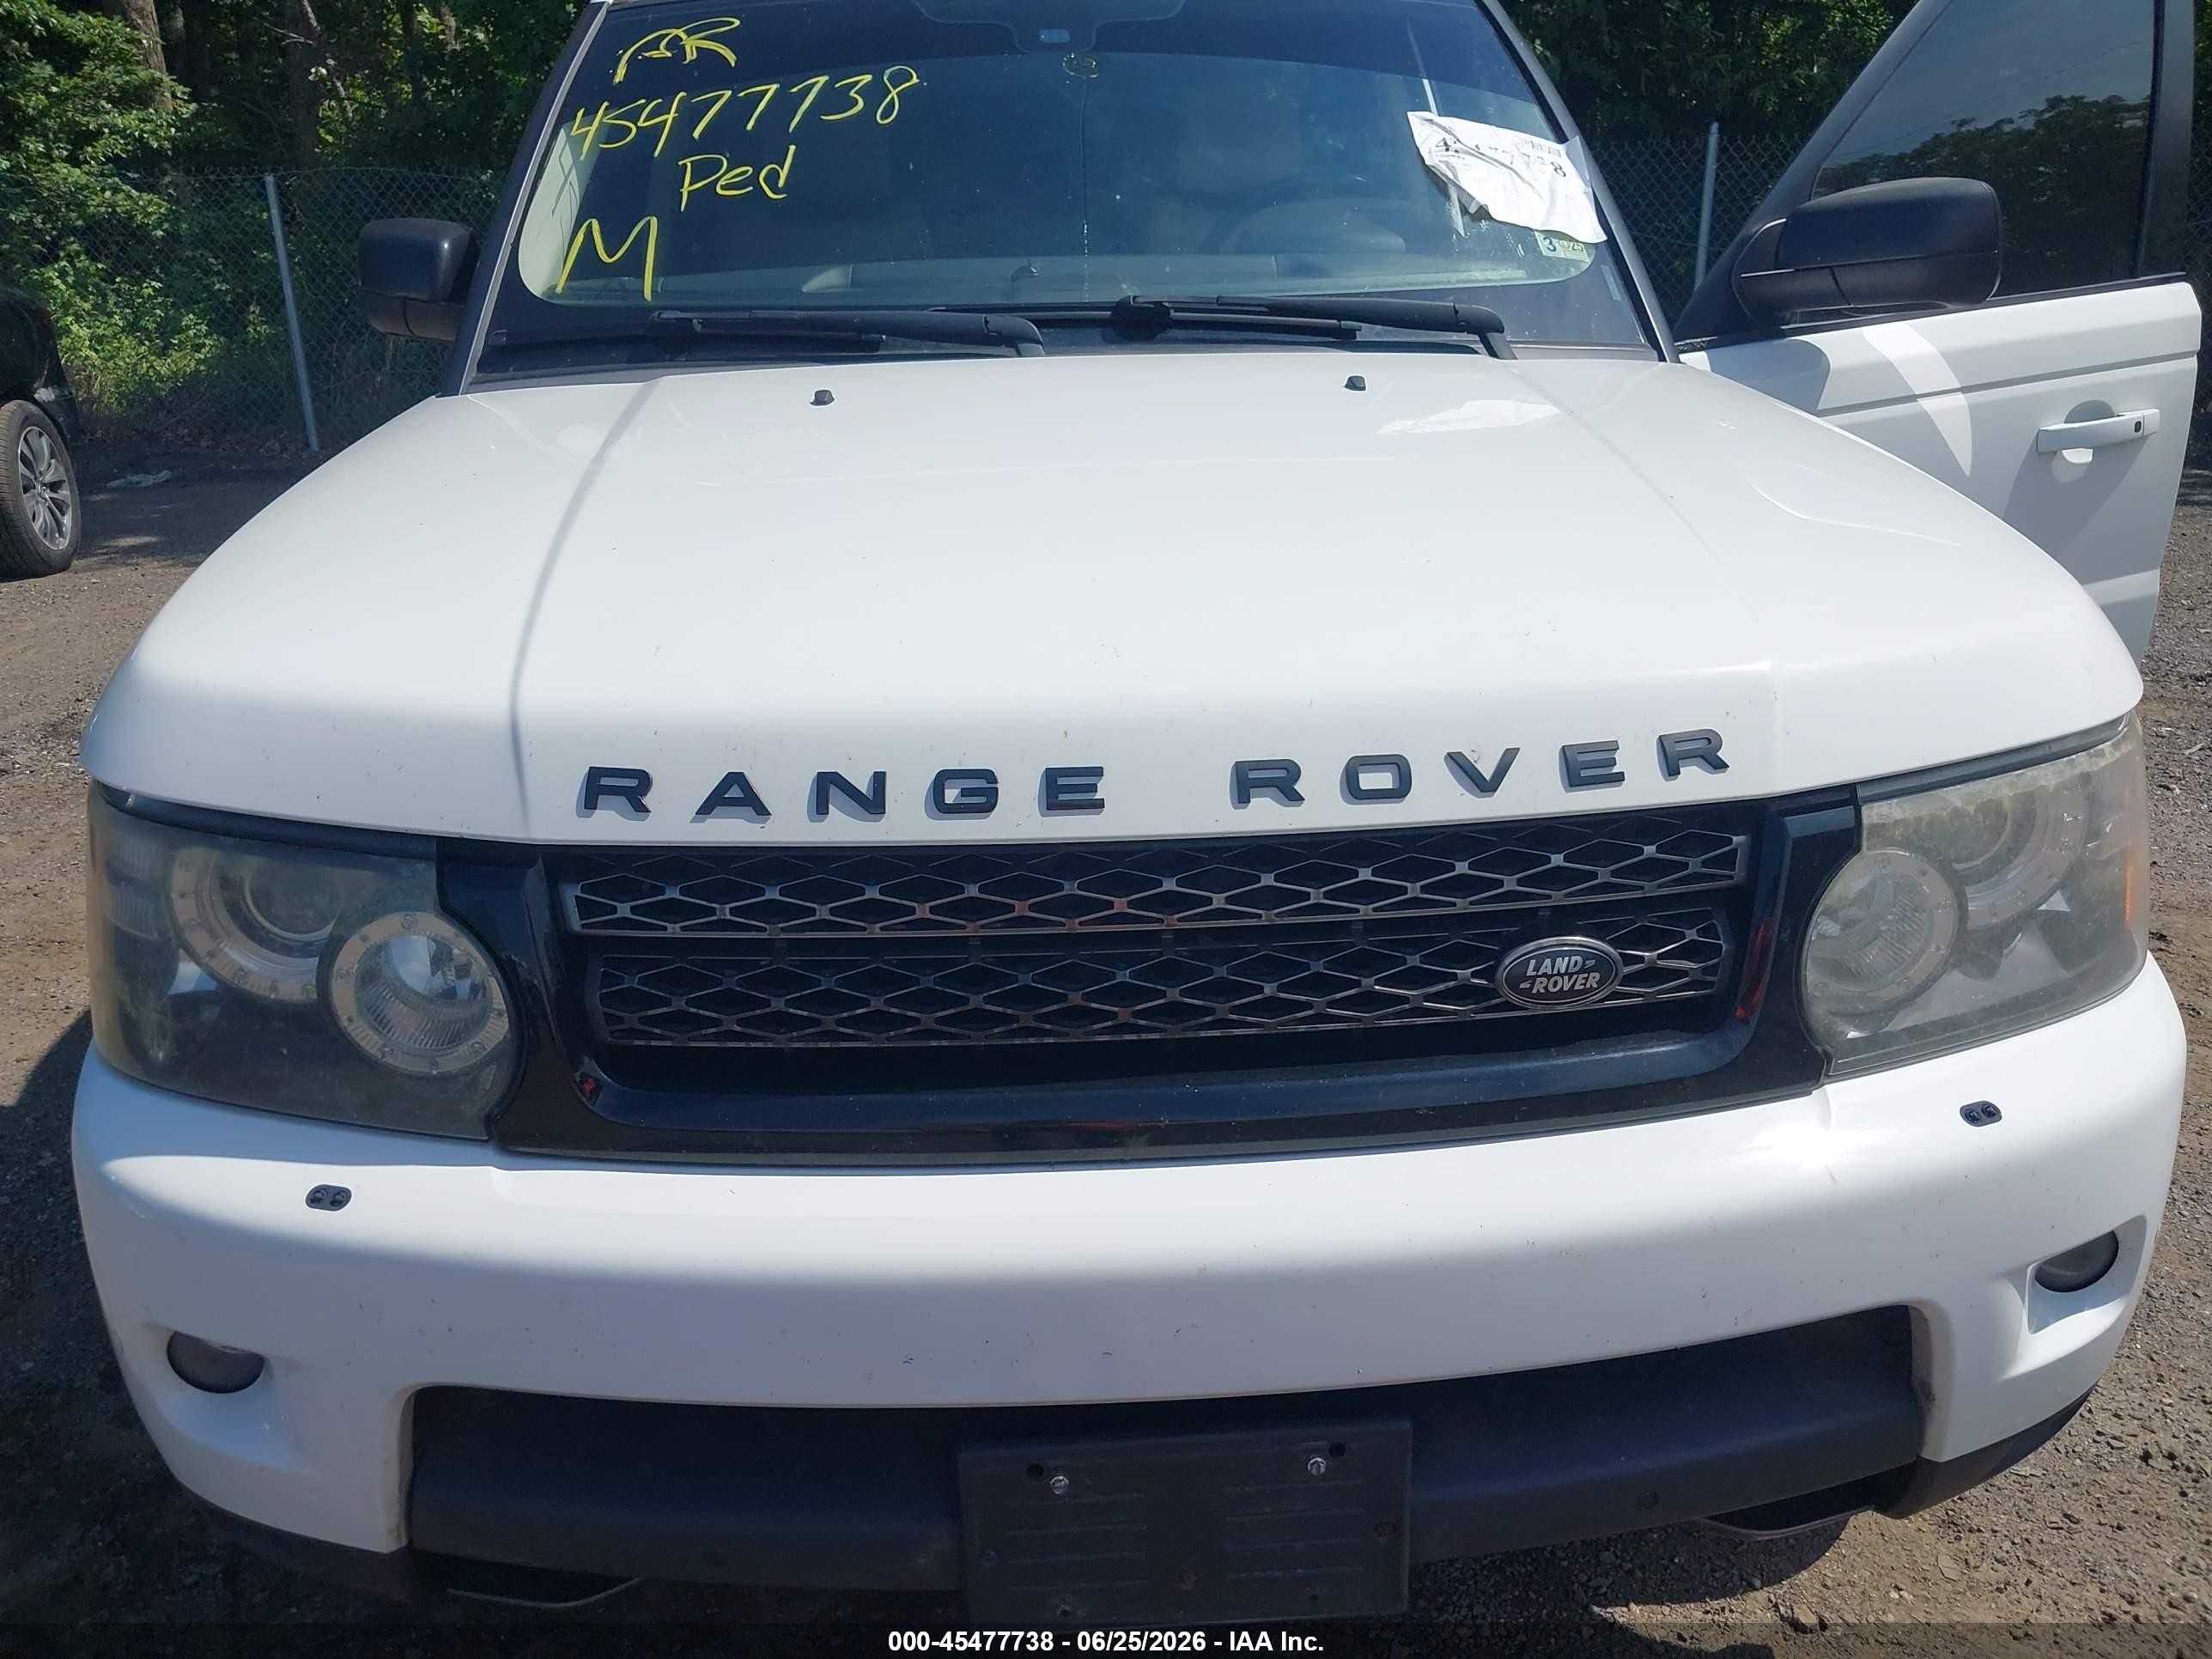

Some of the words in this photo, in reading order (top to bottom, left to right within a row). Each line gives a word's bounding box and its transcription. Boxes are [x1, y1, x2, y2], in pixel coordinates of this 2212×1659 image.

[569, 65, 921, 161] 45477738
[556, 215, 659, 302] M
[1543, 236, 1557, 252] 3
[583, 766, 1106, 816] RANGE
[1234, 728, 1730, 805] ROVER
[1526, 956, 1583, 976] LAND
[1531, 972, 1601, 994] ROVER
